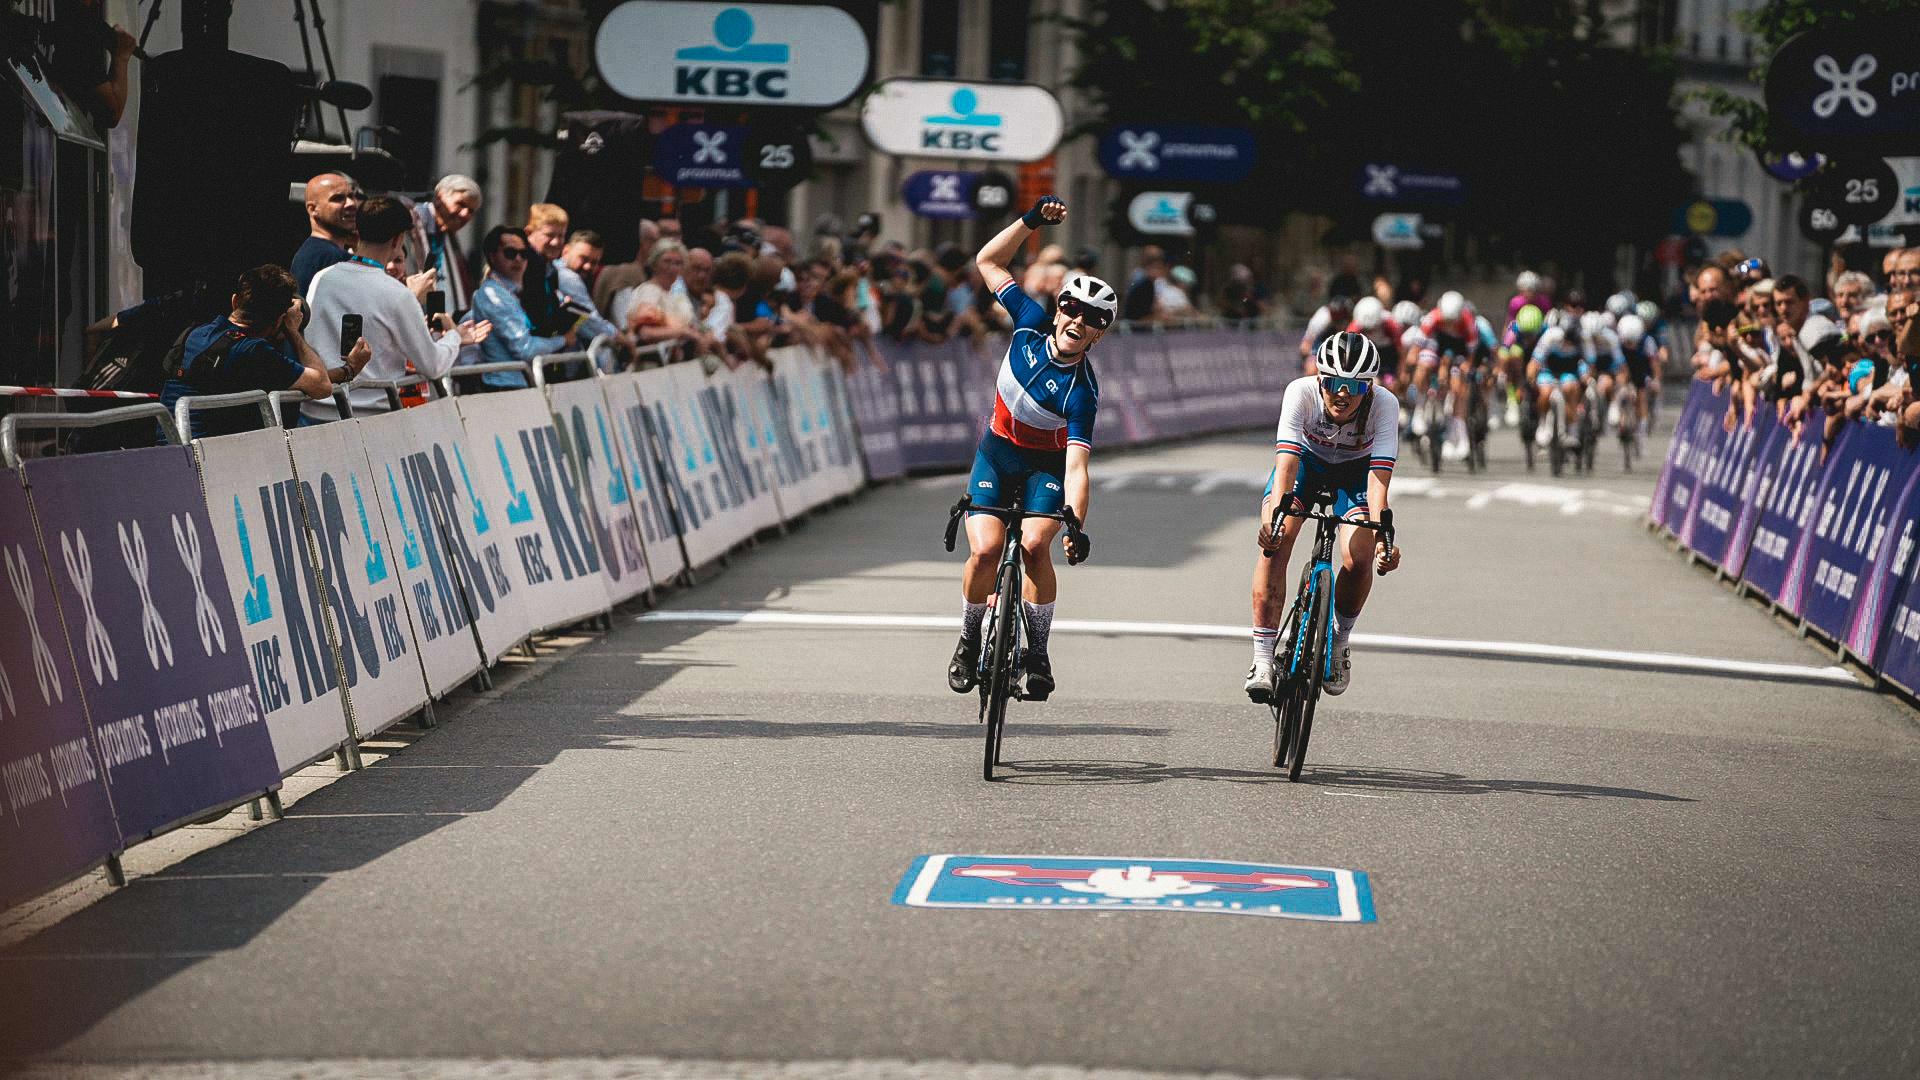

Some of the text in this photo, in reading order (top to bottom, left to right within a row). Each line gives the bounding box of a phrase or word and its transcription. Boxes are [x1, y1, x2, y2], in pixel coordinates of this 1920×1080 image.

[675, 66, 788, 98] KBC
[760, 144, 795, 169] 25
[922, 129, 1002, 152] KBC
[1845, 179, 1880, 203] 25
[518, 404, 621, 582] KBC
[400, 443, 495, 636] KBC
[515, 532, 553, 586] KBC
[258, 472, 380, 704] KBC
[412, 578, 442, 643] KBC
[374, 593, 407, 662] KBC
[251, 634, 291, 714] KBC
[97, 684, 259, 785] proximus proximus proximus
